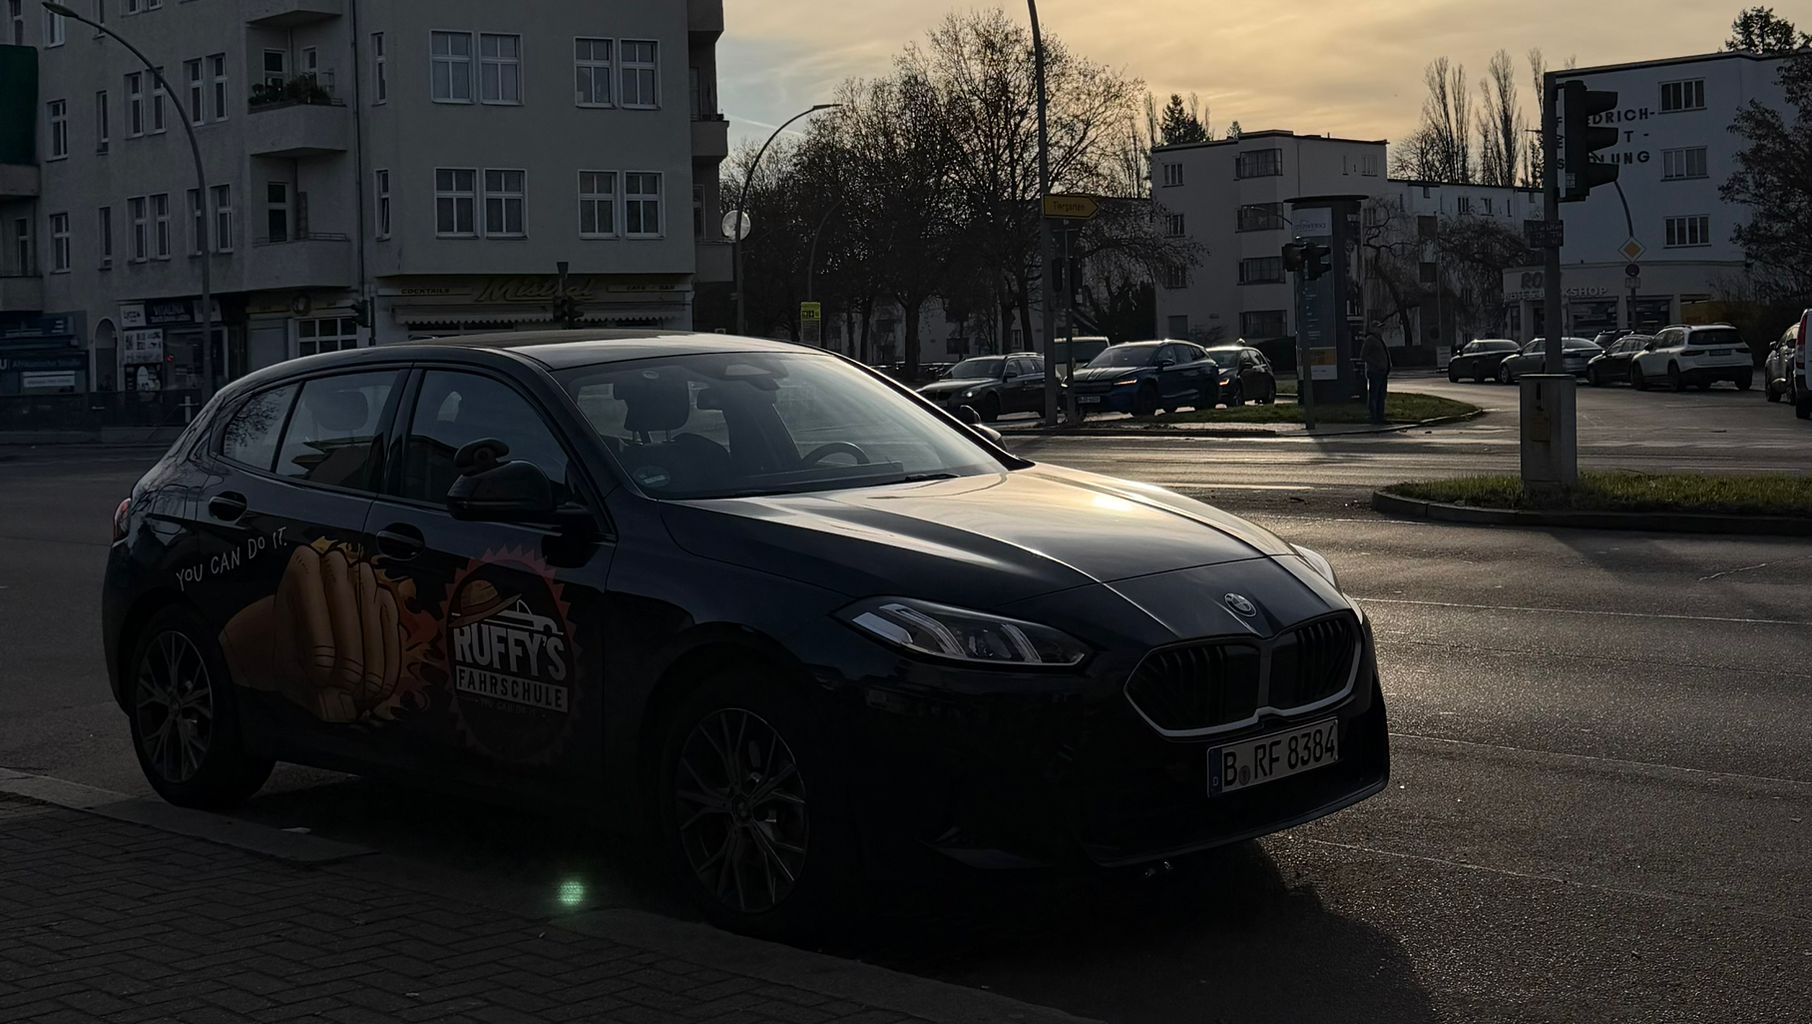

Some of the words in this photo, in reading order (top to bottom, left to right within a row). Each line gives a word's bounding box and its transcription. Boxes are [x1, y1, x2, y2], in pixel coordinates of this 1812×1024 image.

[175, 563, 204, 592] YOU
[210, 545, 241, 575] CAN
[247, 536, 266, 560] DO
[272, 525, 288, 550] IT.
[453, 622, 567, 681] RUFFY'S
[458, 668, 562, 708] FAHRSCHULE
[1223, 751, 1237, 786] B
[1254, 740, 1282, 779] RF
[1287, 726, 1336, 770] 8384
